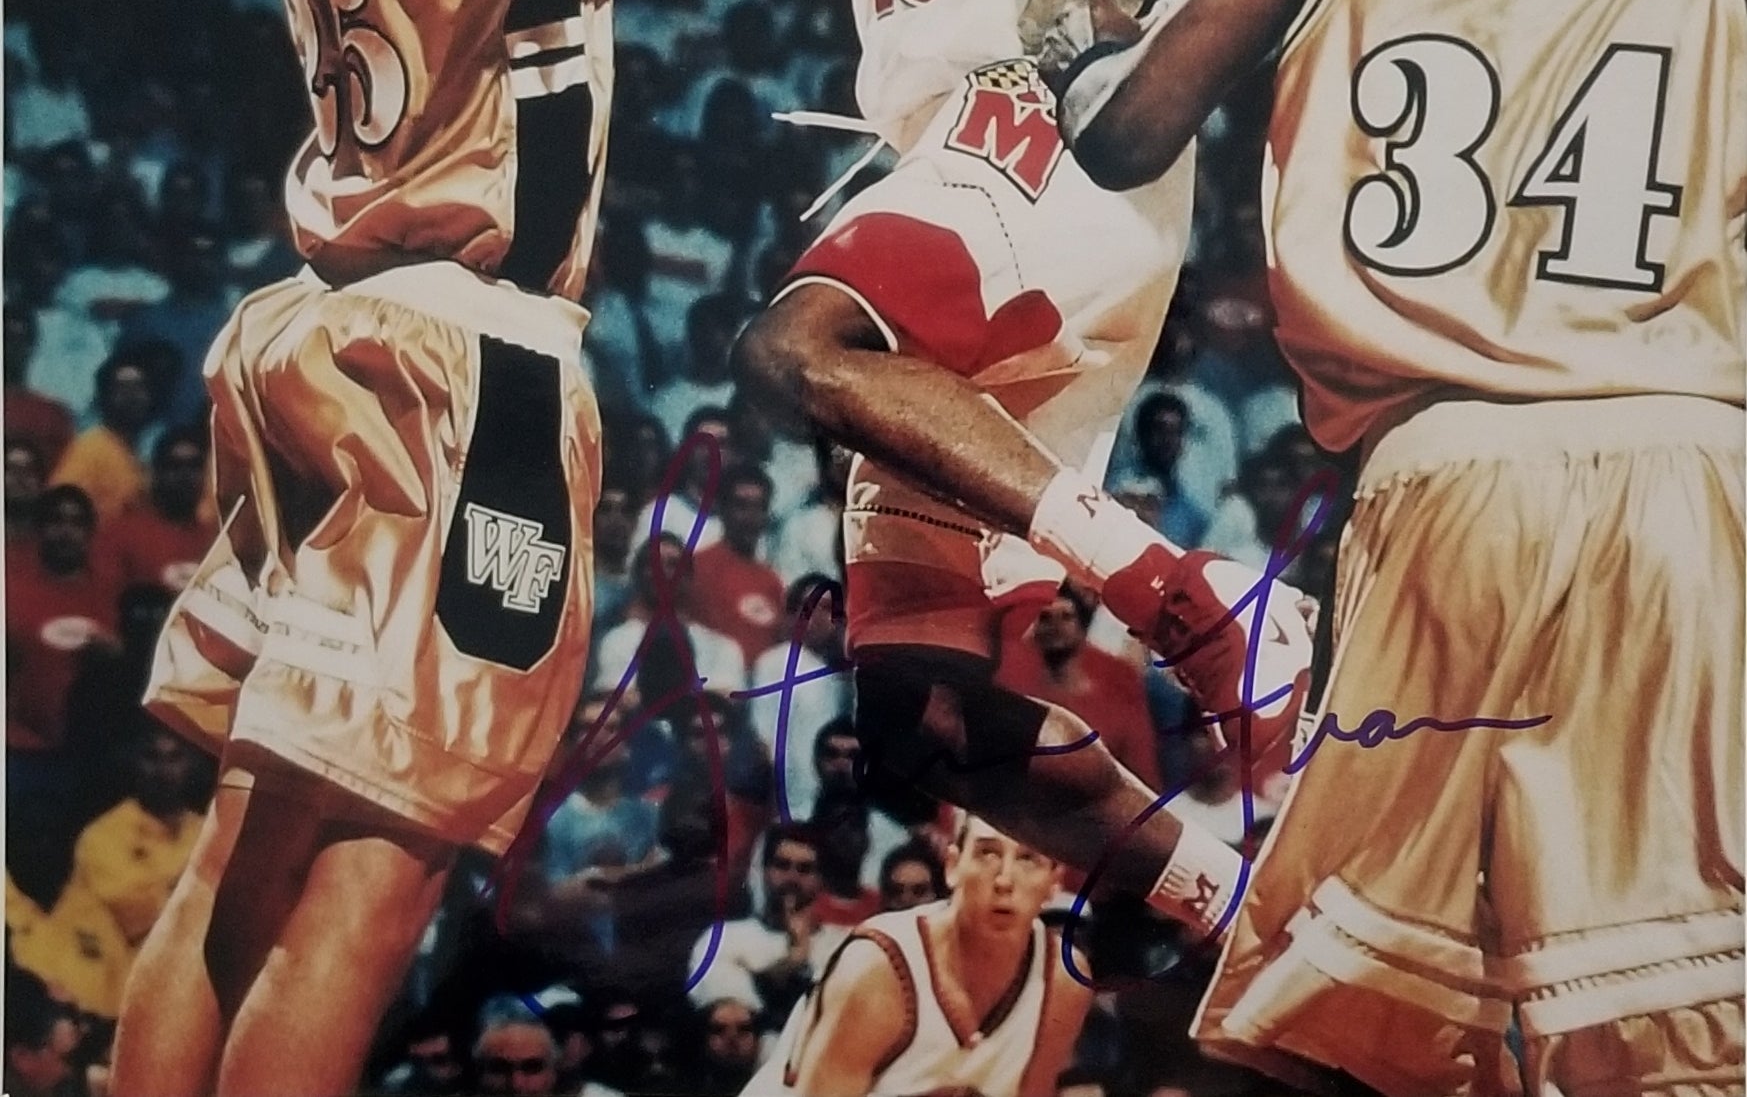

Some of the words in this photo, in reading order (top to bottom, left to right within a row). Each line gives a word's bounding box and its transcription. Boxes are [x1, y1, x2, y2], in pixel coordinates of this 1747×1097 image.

[943, 58, 1067, 204] M
[1343, 32, 1683, 293] 34
[464, 501, 567, 614] WF
